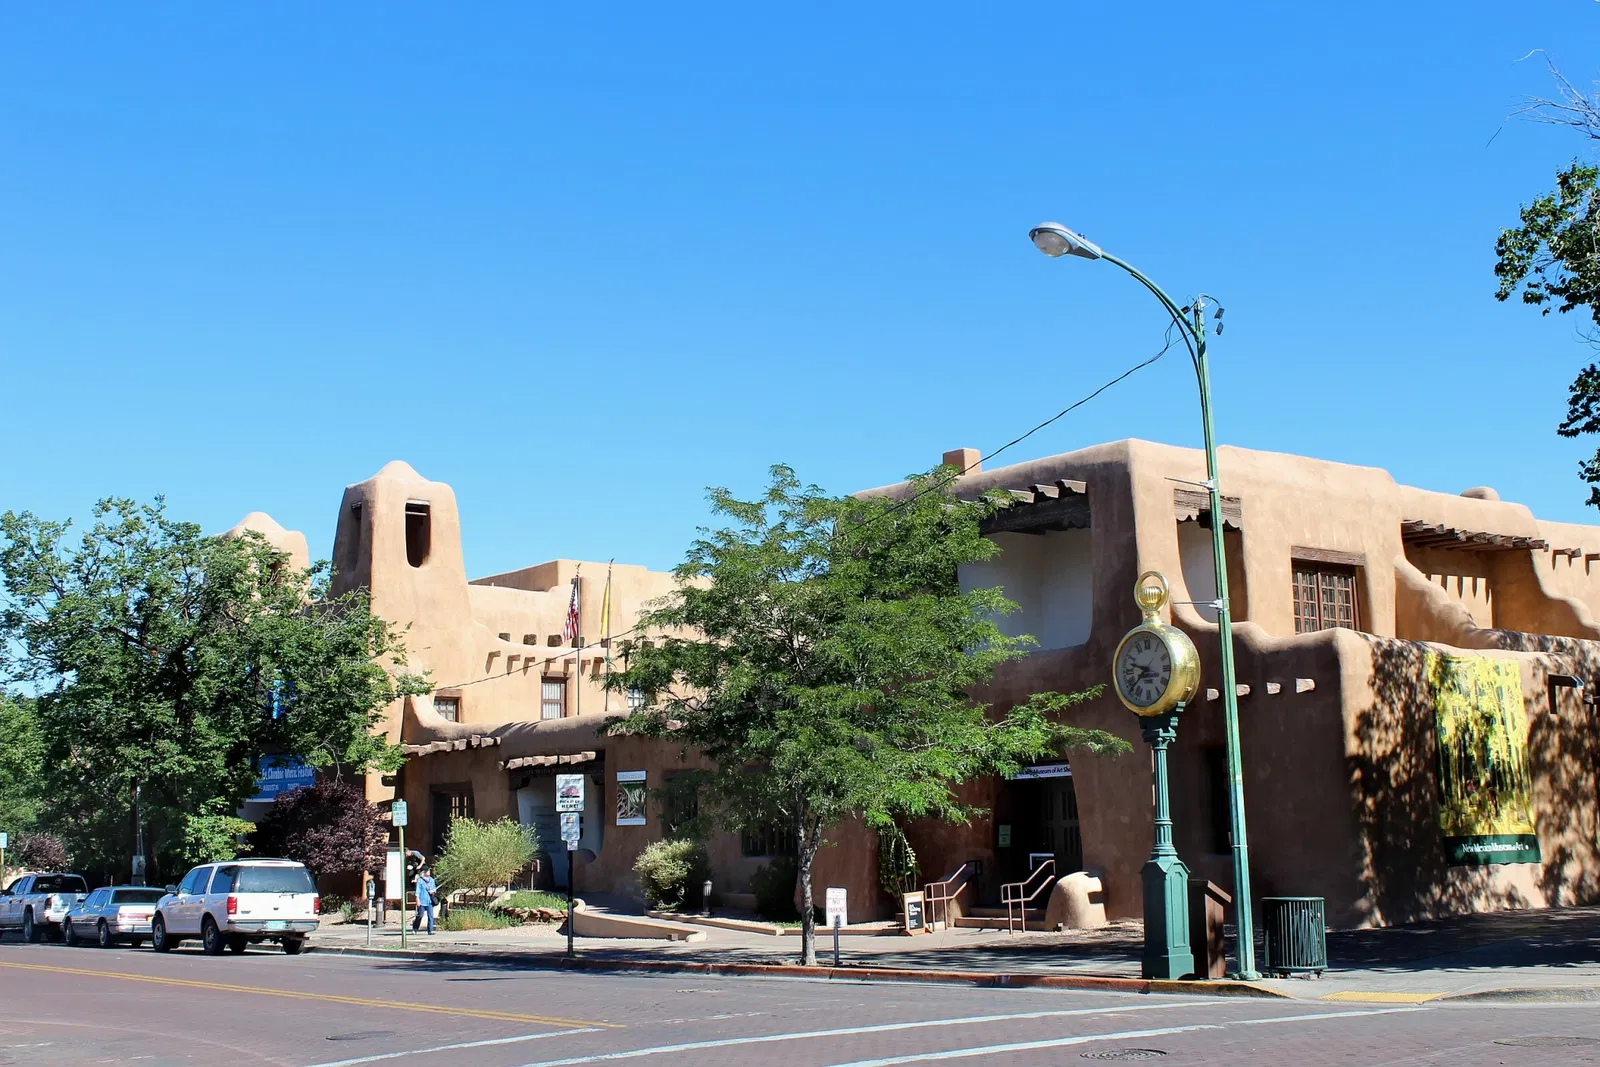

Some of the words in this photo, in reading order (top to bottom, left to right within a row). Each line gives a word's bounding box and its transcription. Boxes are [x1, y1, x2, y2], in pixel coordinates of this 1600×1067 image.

[268, 768, 284, 779] Chamber
[285, 767, 297, 778] Music
[1462, 843, 1474, 852] New
[1474, 843, 1491, 852] Mexico
[1491, 842, 1511, 851] Museum
[1515, 842, 1524, 850] Art
